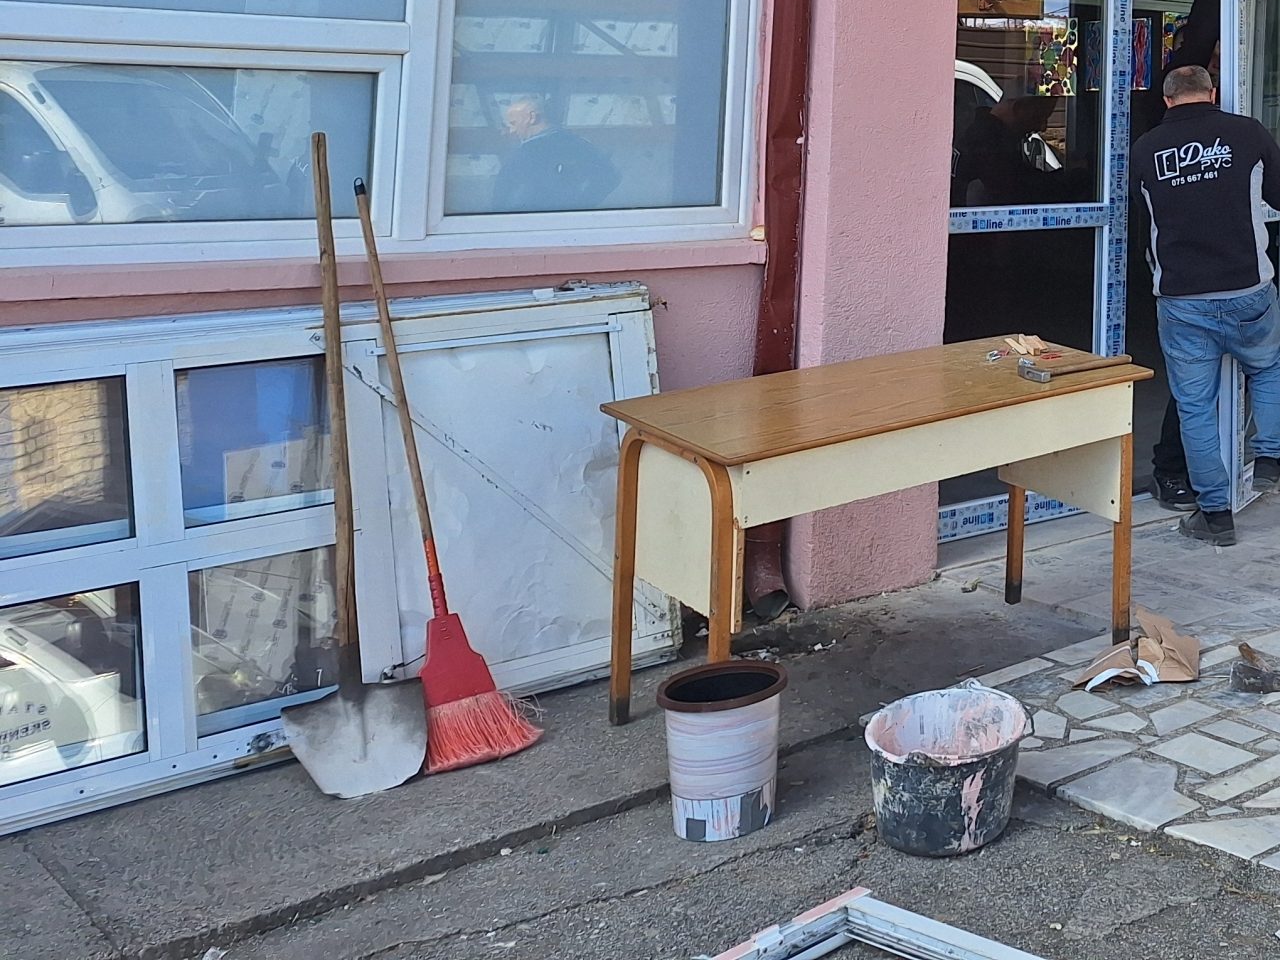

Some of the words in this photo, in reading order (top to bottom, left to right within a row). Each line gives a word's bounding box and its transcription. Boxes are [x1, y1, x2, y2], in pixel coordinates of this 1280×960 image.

[1180, 137, 1232, 167] Dako
[1201, 157, 1232, 170] PVC
[1171, 177, 1185, 187] 075
[1187, 174, 1202, 183] 667
[1204, 171, 1218, 180] 461
